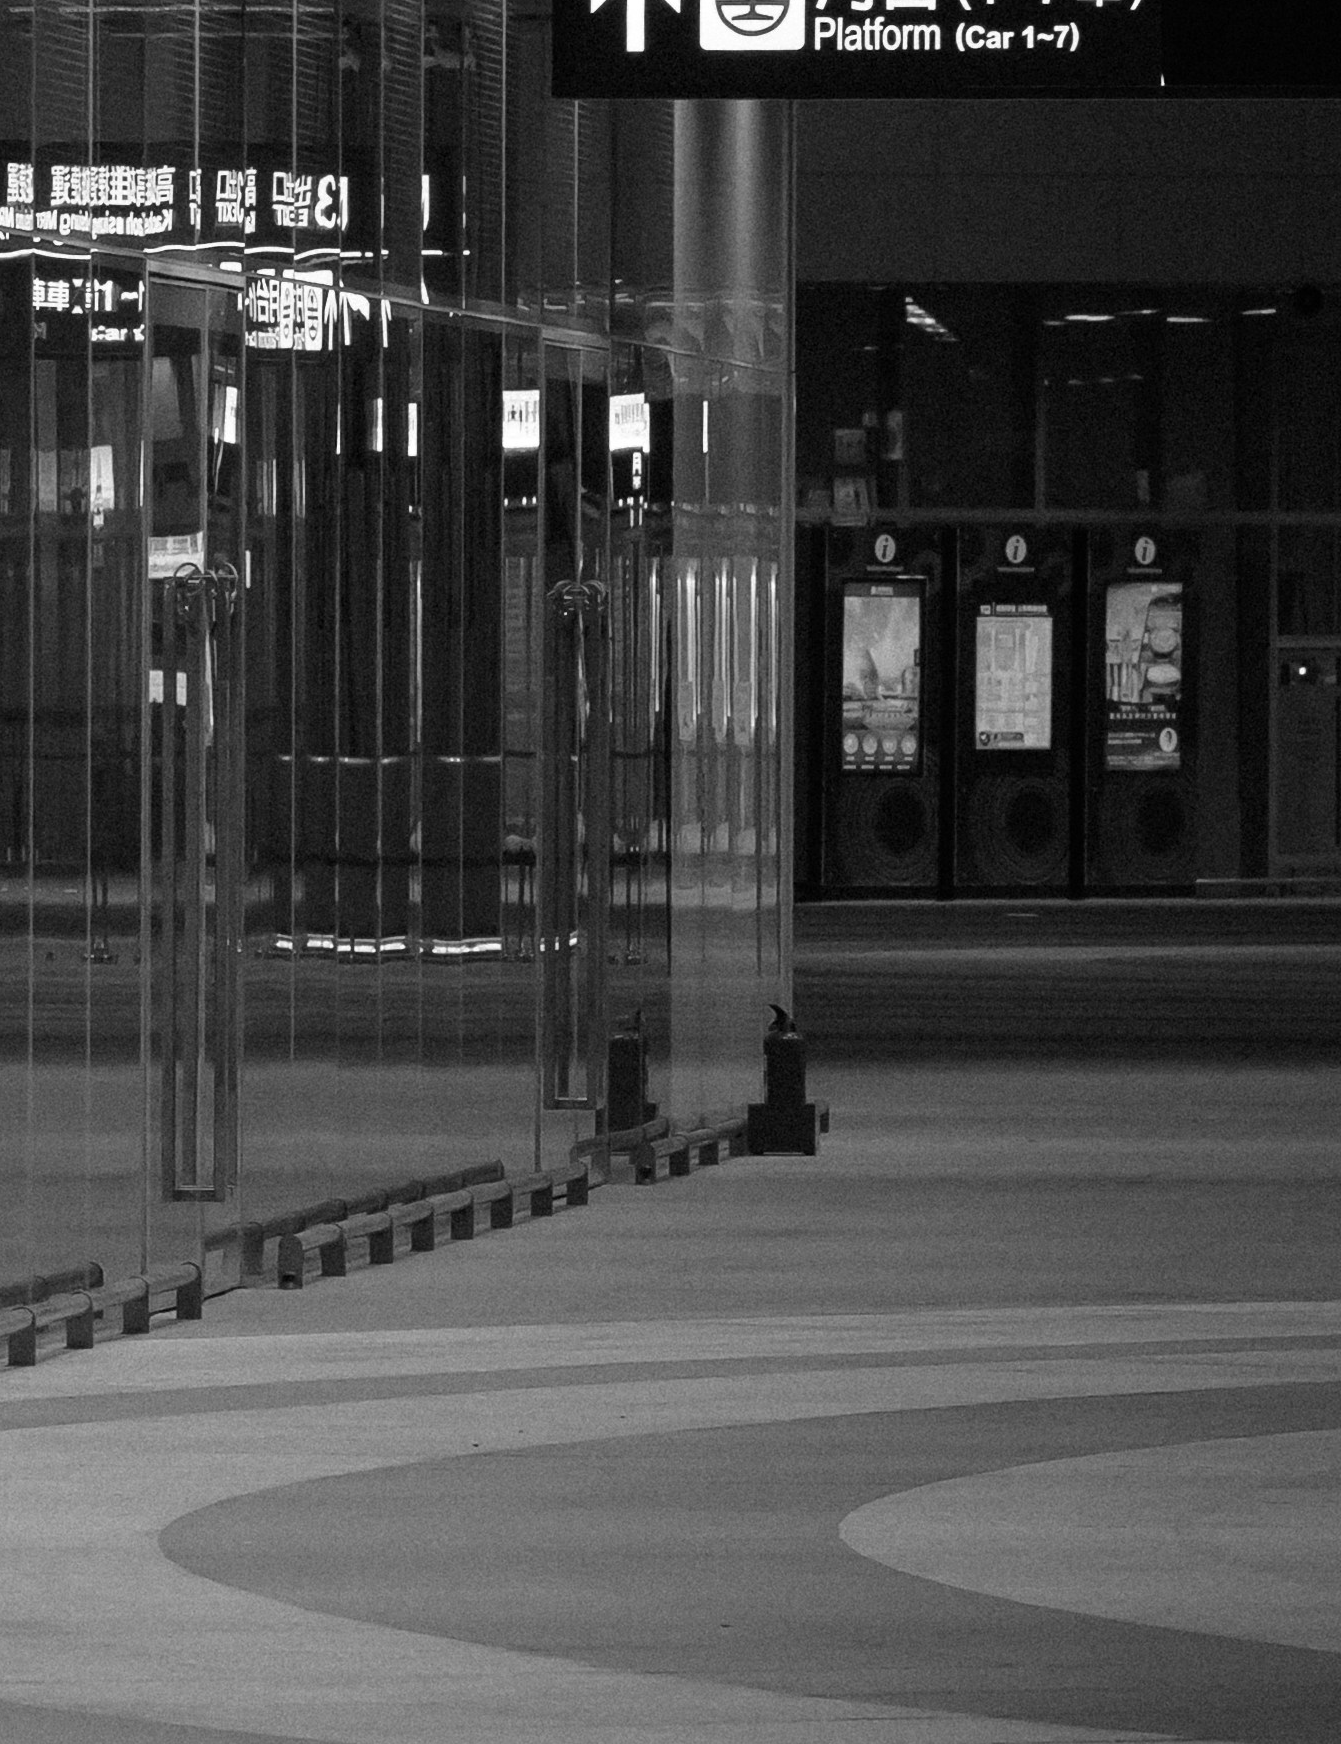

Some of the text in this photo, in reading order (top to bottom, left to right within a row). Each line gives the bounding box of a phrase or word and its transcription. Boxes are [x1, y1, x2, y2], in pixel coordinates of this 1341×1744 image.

[814, 16, 1080, 53] Platform (Car 1~7)
